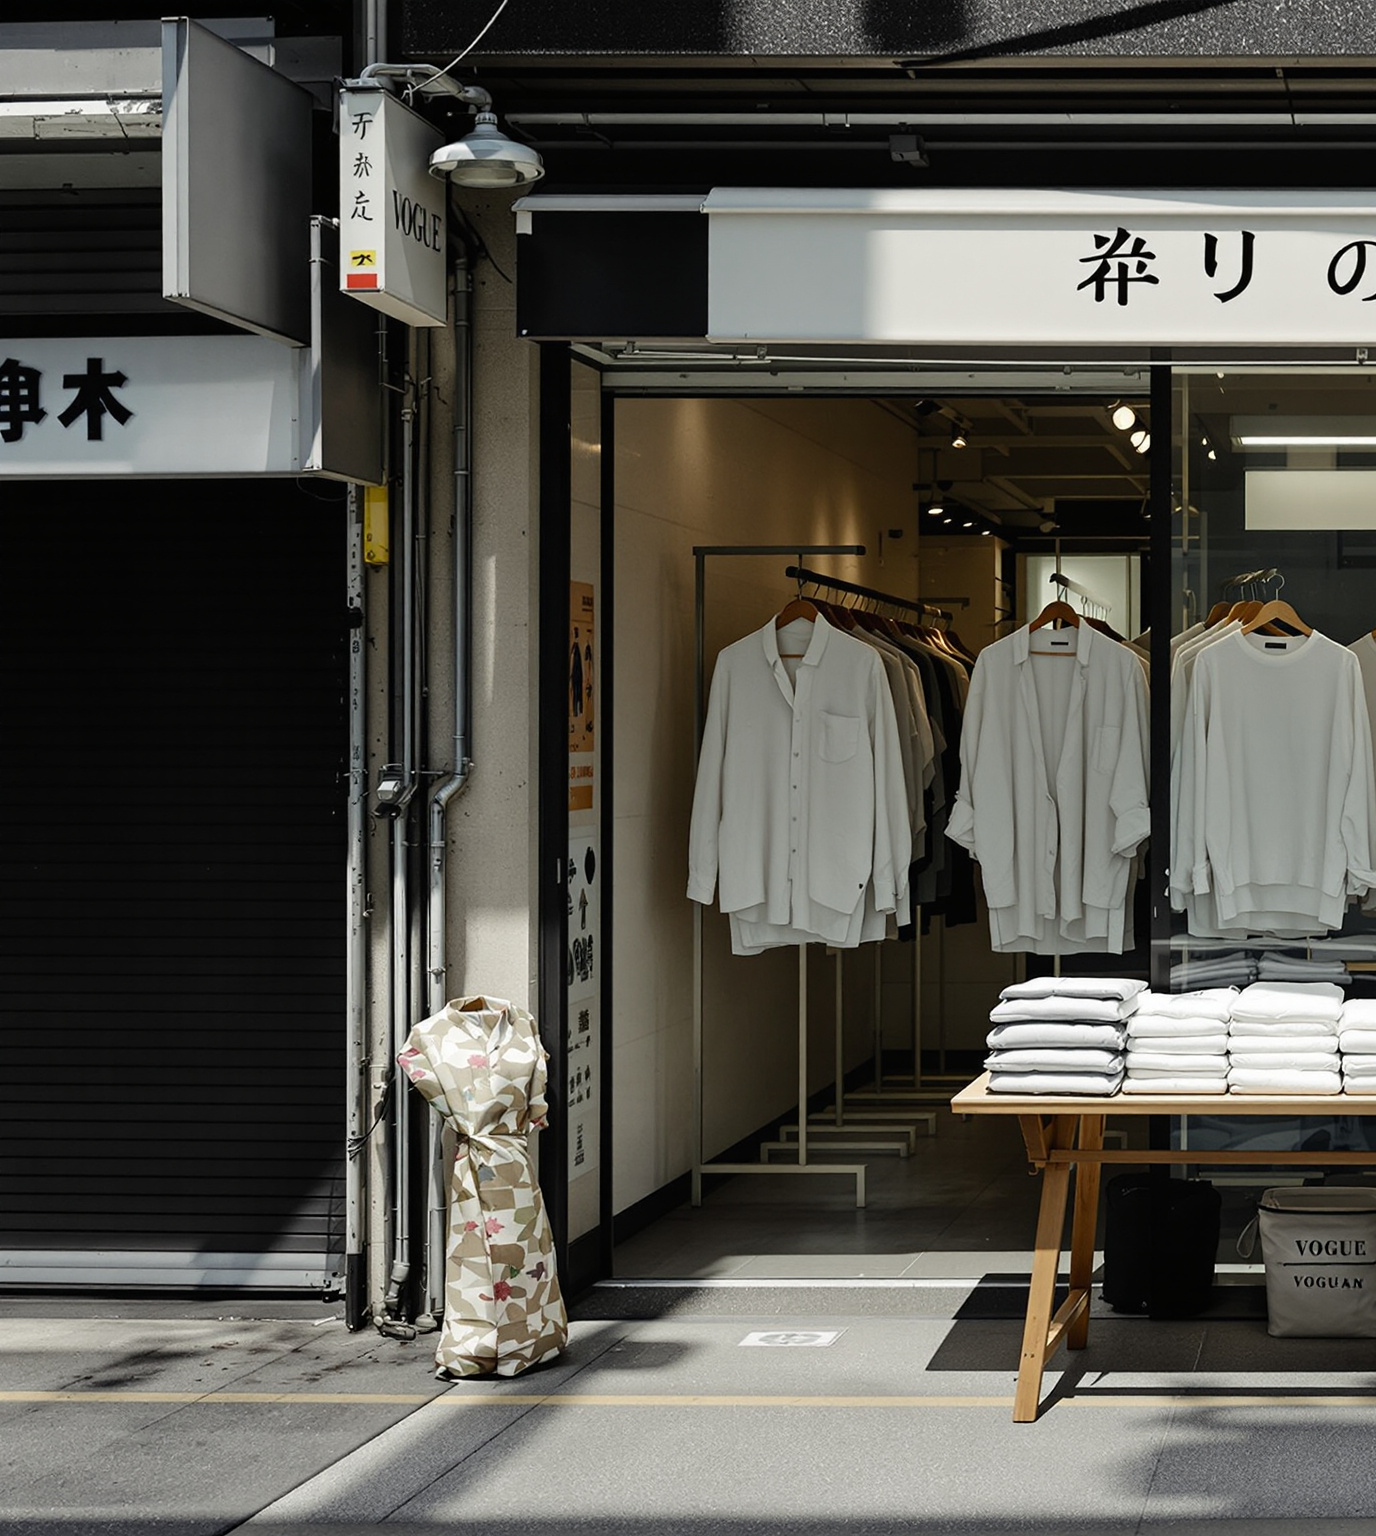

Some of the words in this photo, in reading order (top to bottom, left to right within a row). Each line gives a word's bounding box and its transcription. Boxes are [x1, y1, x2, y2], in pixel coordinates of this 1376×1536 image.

[392, 188, 442, 253] VOGUE
[1295, 1240, 1366, 1256] VOGUE
[1294, 1275, 1364, 1289] VOGUAN
